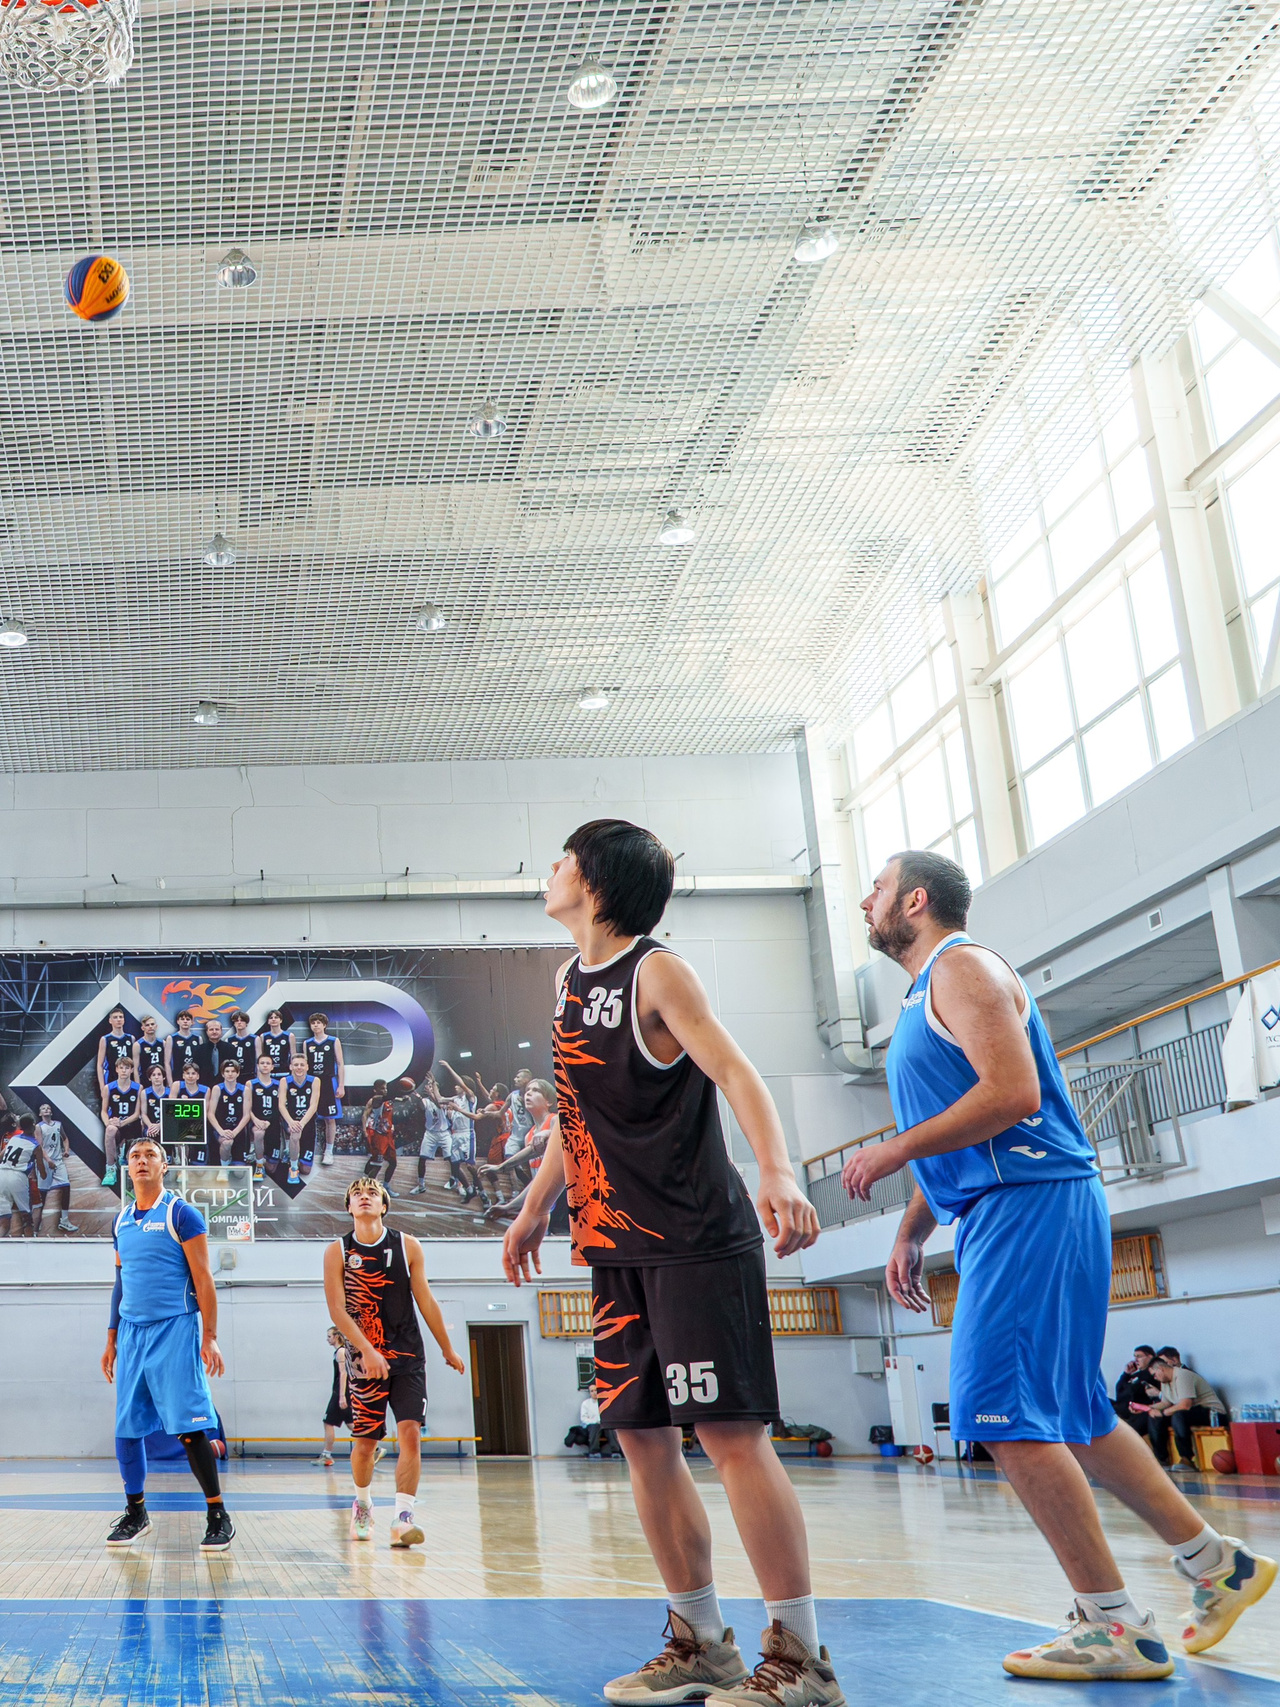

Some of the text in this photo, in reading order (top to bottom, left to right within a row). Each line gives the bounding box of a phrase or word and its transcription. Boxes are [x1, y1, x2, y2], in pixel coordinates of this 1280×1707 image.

[582, 986, 624, 1029] 35
[185, 1045, 193, 1057] 4
[269, 1044, 280, 1056] 22
[150, 1052, 160, 1063] 23
[313, 1051, 324, 1063] 15
[261, 1095, 272, 1108] 19
[295, 1095, 307, 1108] 12
[118, 1102, 129, 1115] 13
[228, 1103, 235, 1116] 5
[328, 1104, 337, 1115] 15
[383, 1248, 393, 1268] 7
[665, 1360, 720, 1406] 35
